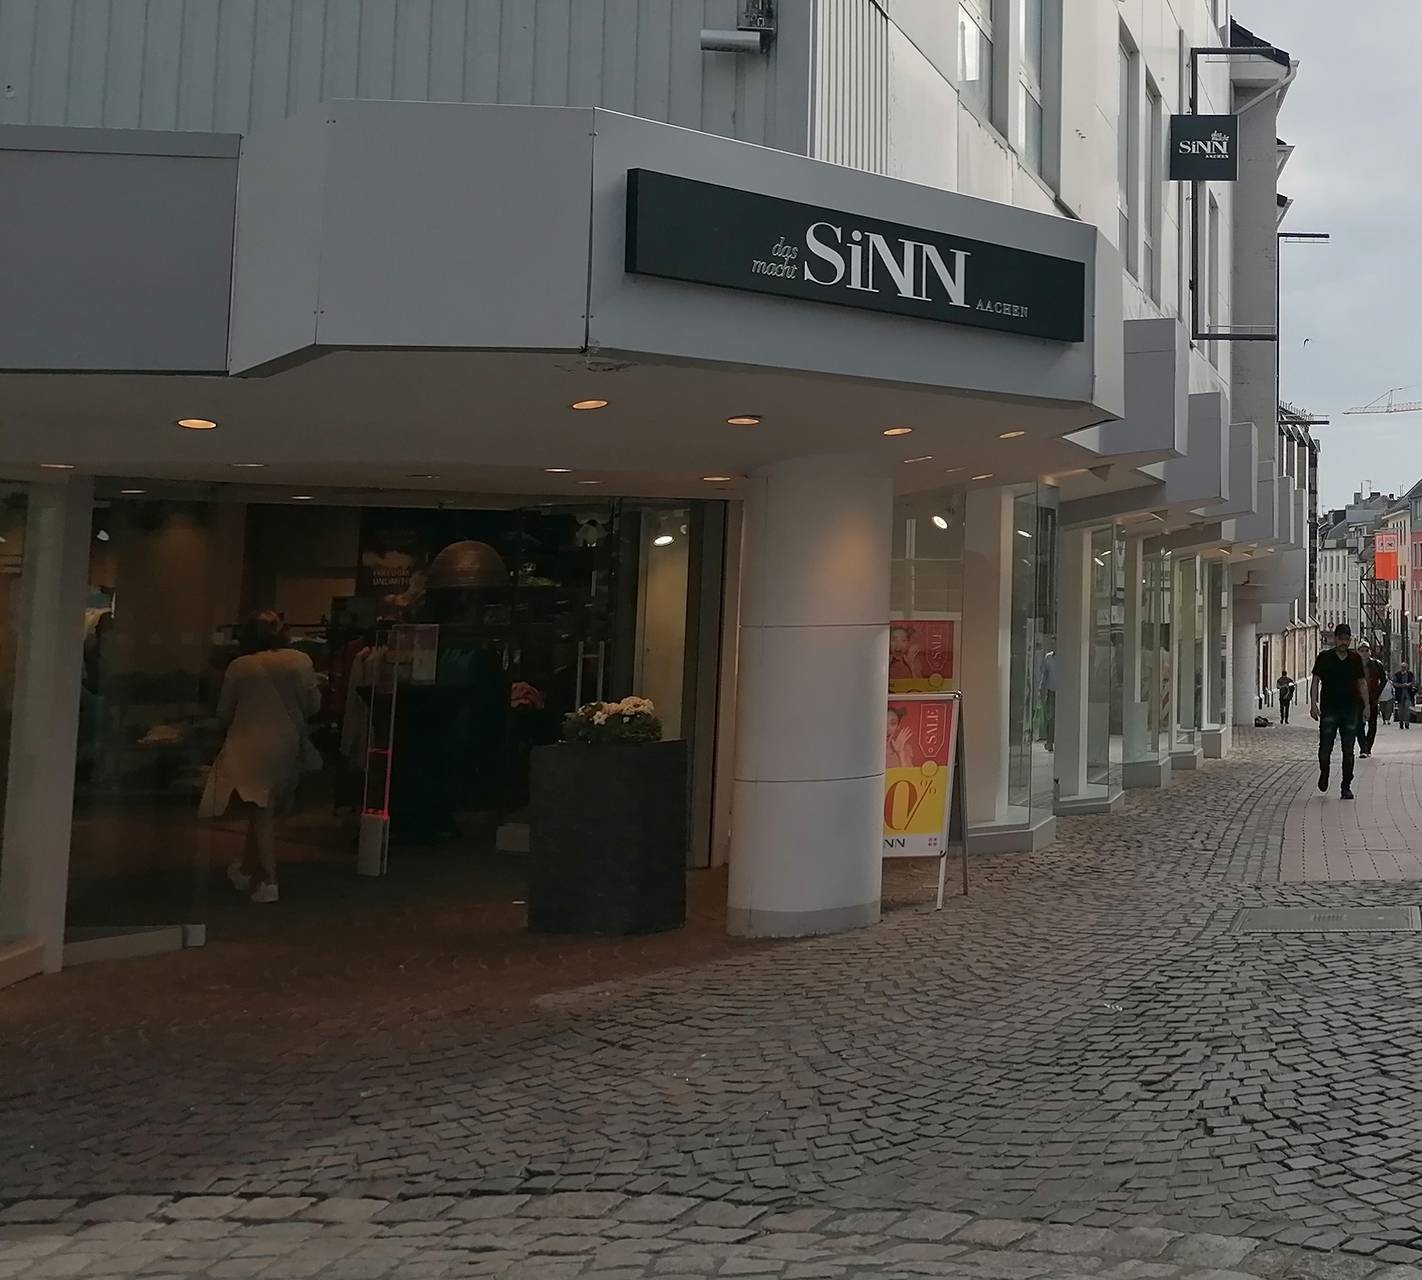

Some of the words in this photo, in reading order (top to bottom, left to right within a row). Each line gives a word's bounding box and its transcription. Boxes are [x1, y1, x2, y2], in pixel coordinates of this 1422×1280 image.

[1179, 140, 1228, 153] SiNN
[771, 236, 799, 260] das
[751, 256, 798, 280] macht
[803, 222, 972, 308] SiNN
[975, 298, 1030, 318] AACHEN
[926, 709, 939, 744] SALE
